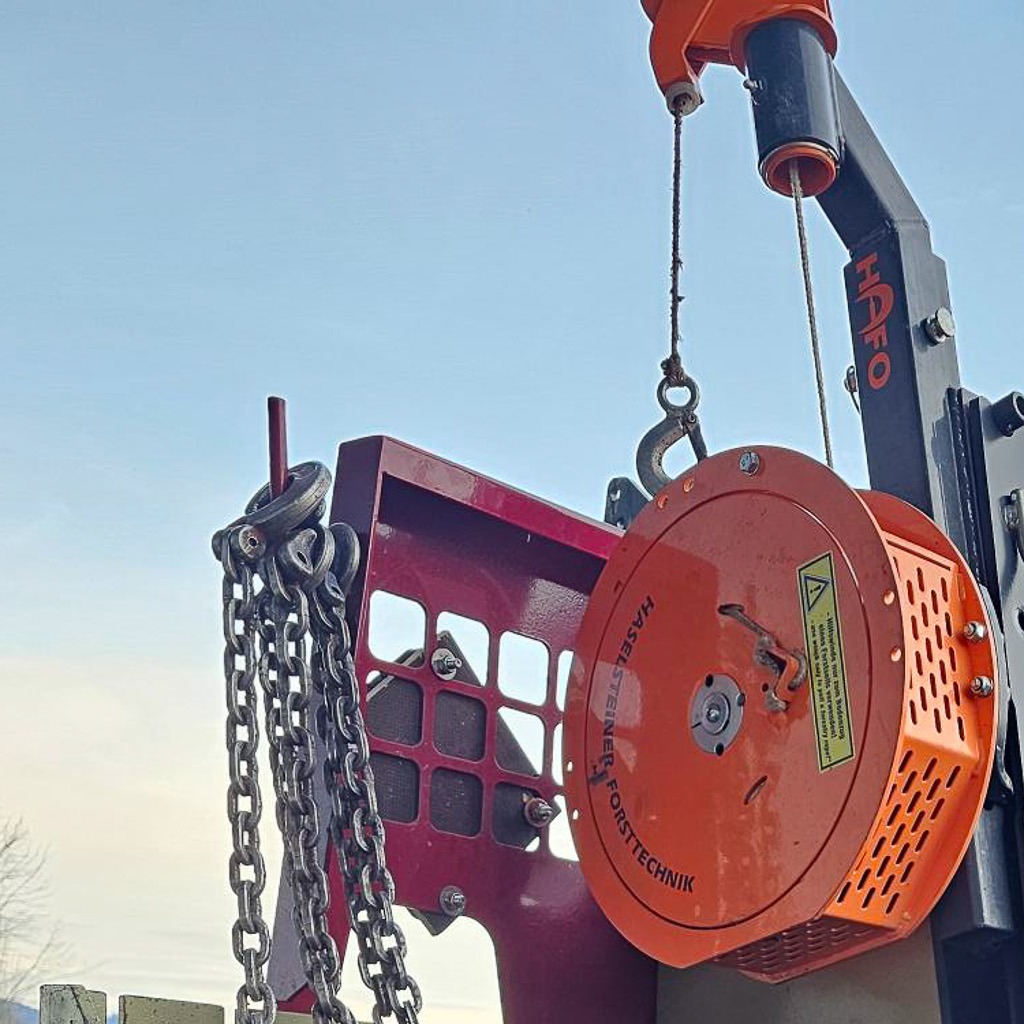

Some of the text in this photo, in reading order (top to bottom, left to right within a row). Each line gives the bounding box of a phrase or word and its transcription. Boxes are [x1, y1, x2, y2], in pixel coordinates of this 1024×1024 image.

[856, 252, 895, 390] HAFO
[603, 595, 696, 893] HASELSTEINER FORSTTECHNIK
